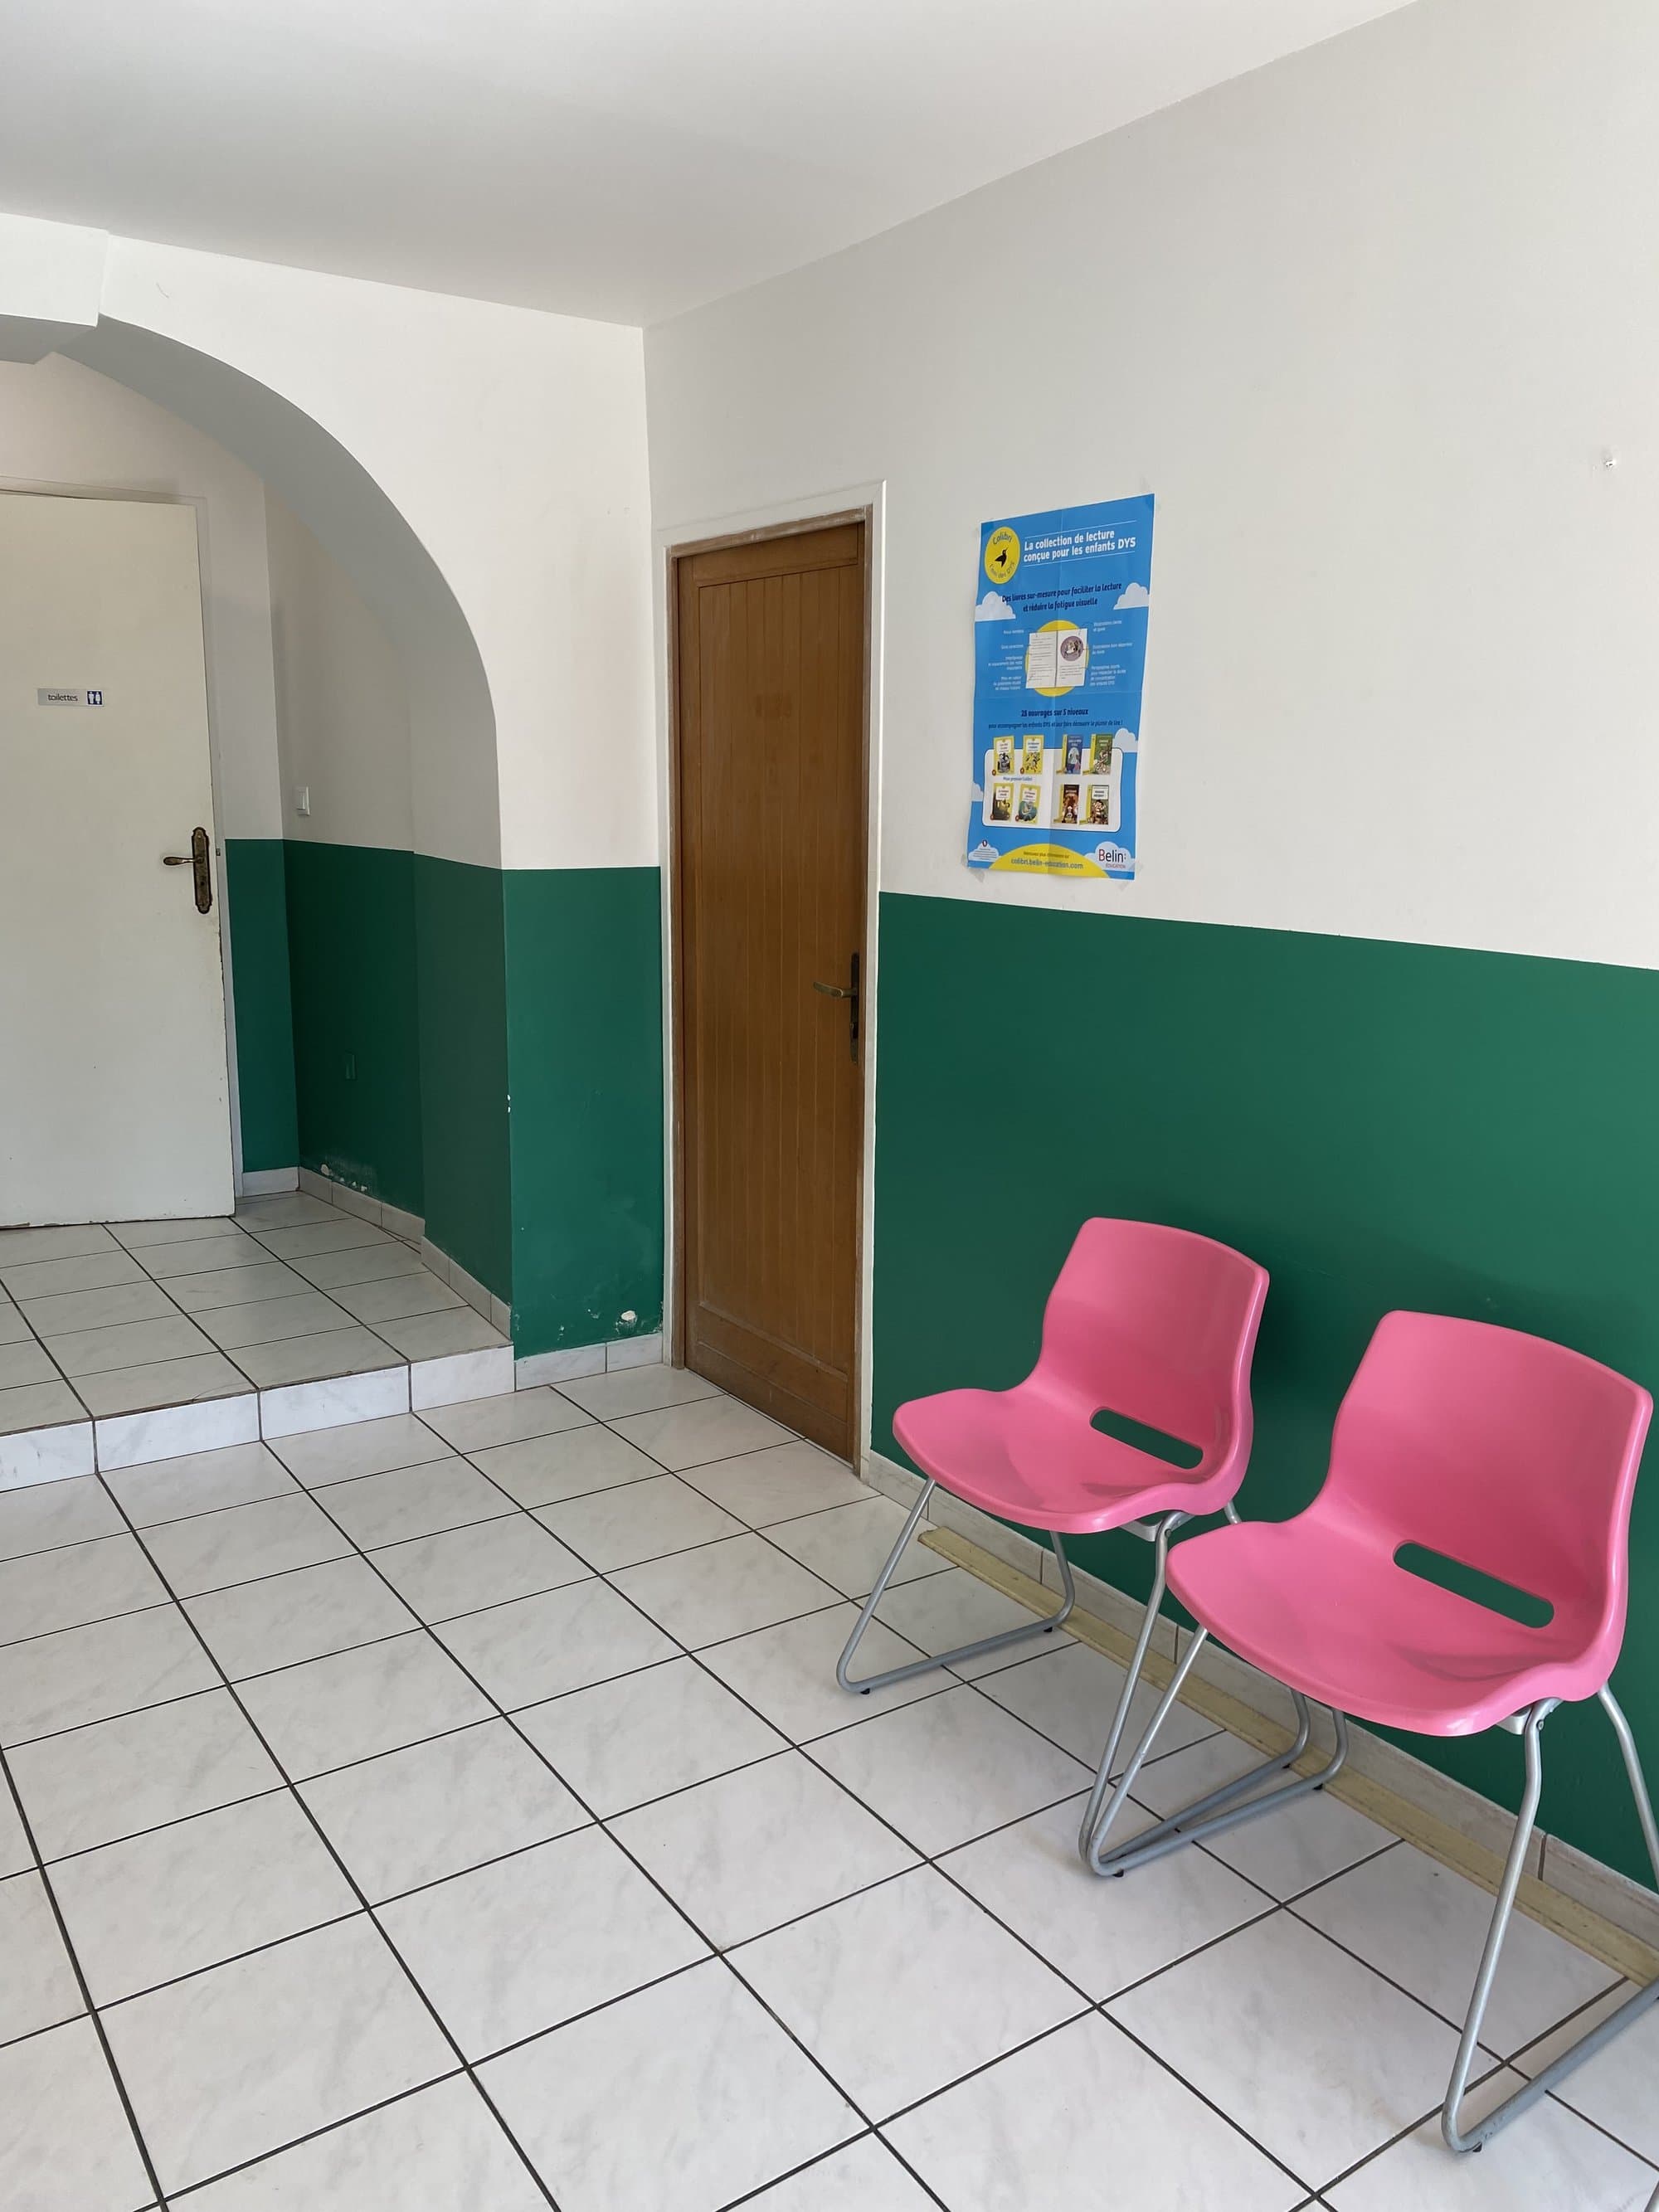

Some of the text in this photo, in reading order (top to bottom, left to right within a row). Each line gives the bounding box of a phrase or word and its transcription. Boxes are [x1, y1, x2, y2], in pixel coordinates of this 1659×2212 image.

[993, 531, 1012, 545] Colibri
[1024, 530, 1115, 552] La collection de lecture
[1024, 537, 1136, 563] conçue pour les enfants DYS
[1002, 582, 1122, 603] Des livres sur-mesure pour faciliter la lecture
[1023, 597, 1098, 612] et réduire la fatigue visuelle
[48, 693, 79, 702] toilettes
[1028, 709, 1053, 718] ouvrages
[1067, 707, 1089, 716] niveaux
